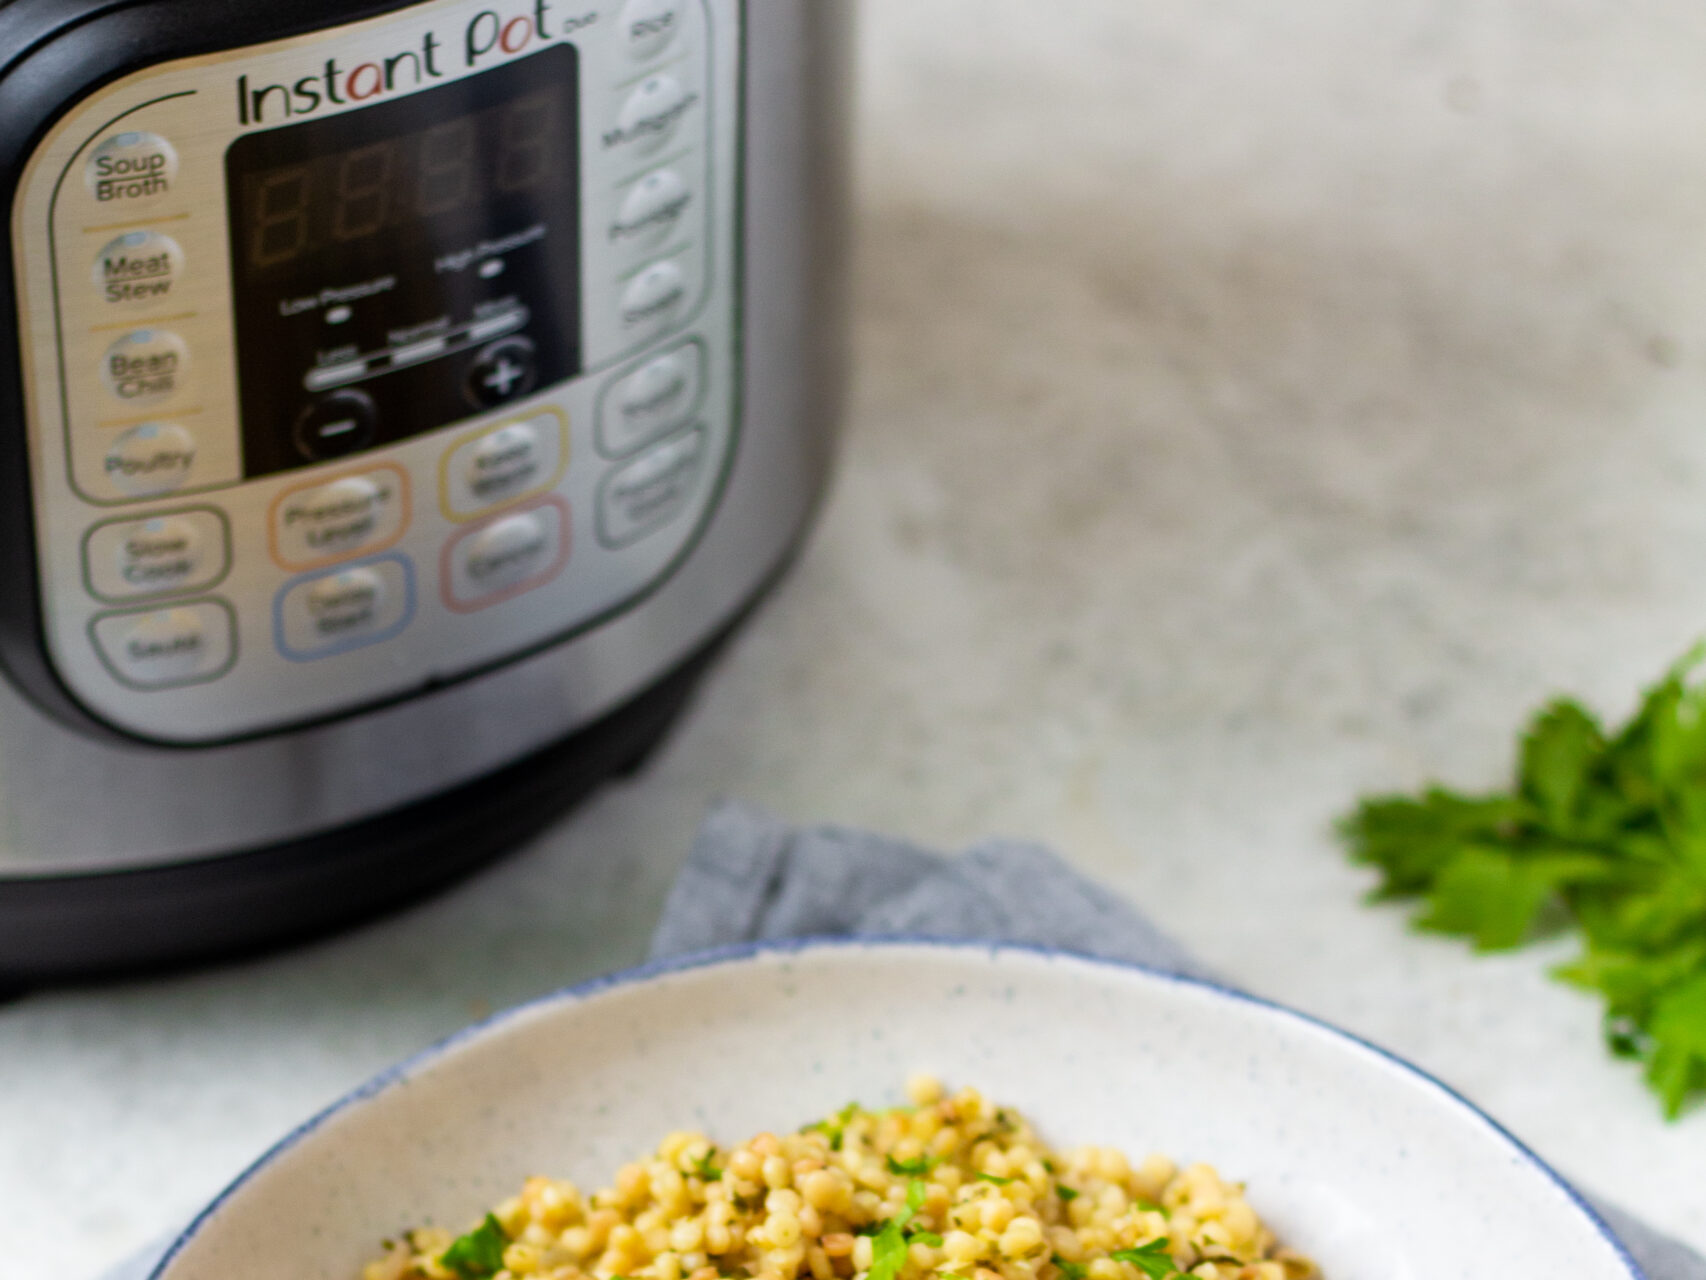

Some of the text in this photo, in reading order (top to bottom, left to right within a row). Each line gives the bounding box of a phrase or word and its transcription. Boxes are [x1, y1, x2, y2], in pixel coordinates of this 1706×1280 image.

[237, 31, 443, 126] Instant
[465, 0, 552, 66] Pot
[96, 153, 166, 178] Soup
[96, 177, 168, 201] Broth
[104, 253, 170, 277] Meat
[105, 279, 172, 302] Stew
[279, 275, 395, 317] Low Pressure
[110, 351, 178, 376] Bean
[105, 450, 195, 476] Poultry
